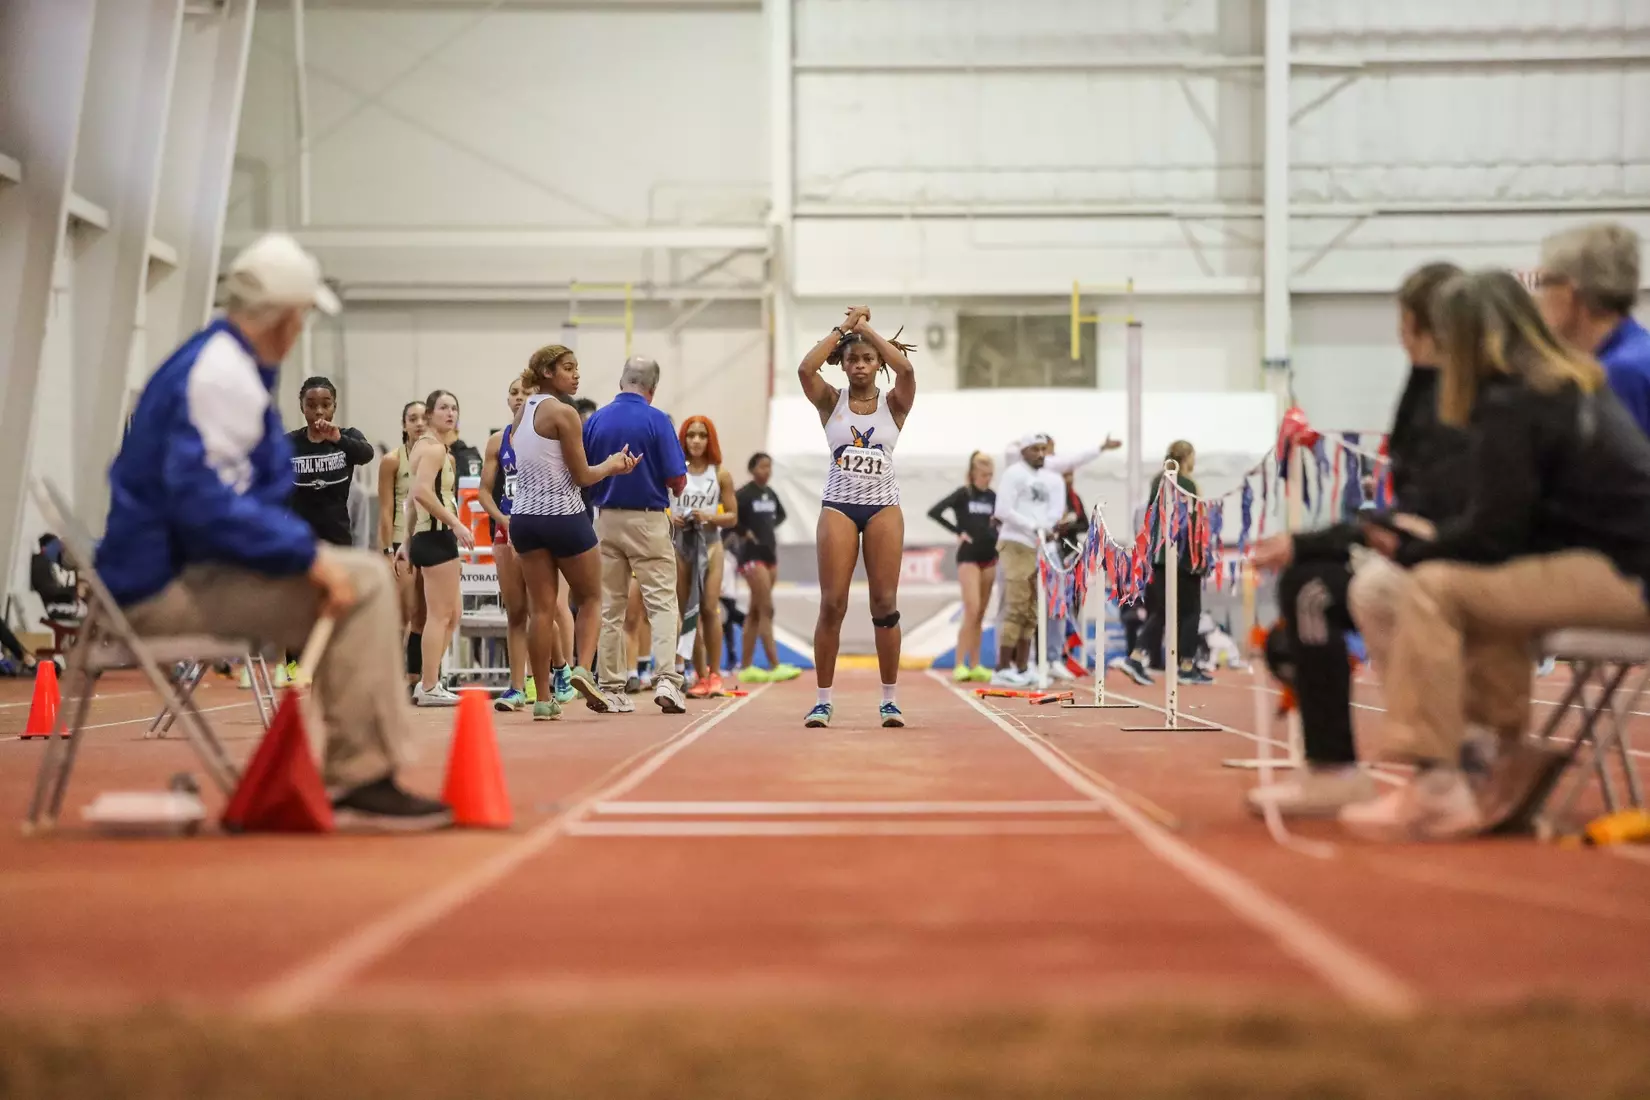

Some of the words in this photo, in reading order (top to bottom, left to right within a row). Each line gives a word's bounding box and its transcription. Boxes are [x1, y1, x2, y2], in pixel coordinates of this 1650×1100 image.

[842, 454, 883, 475] 1231
[676, 494, 706, 509] 1027
[460, 574, 499, 582] ATORAD
